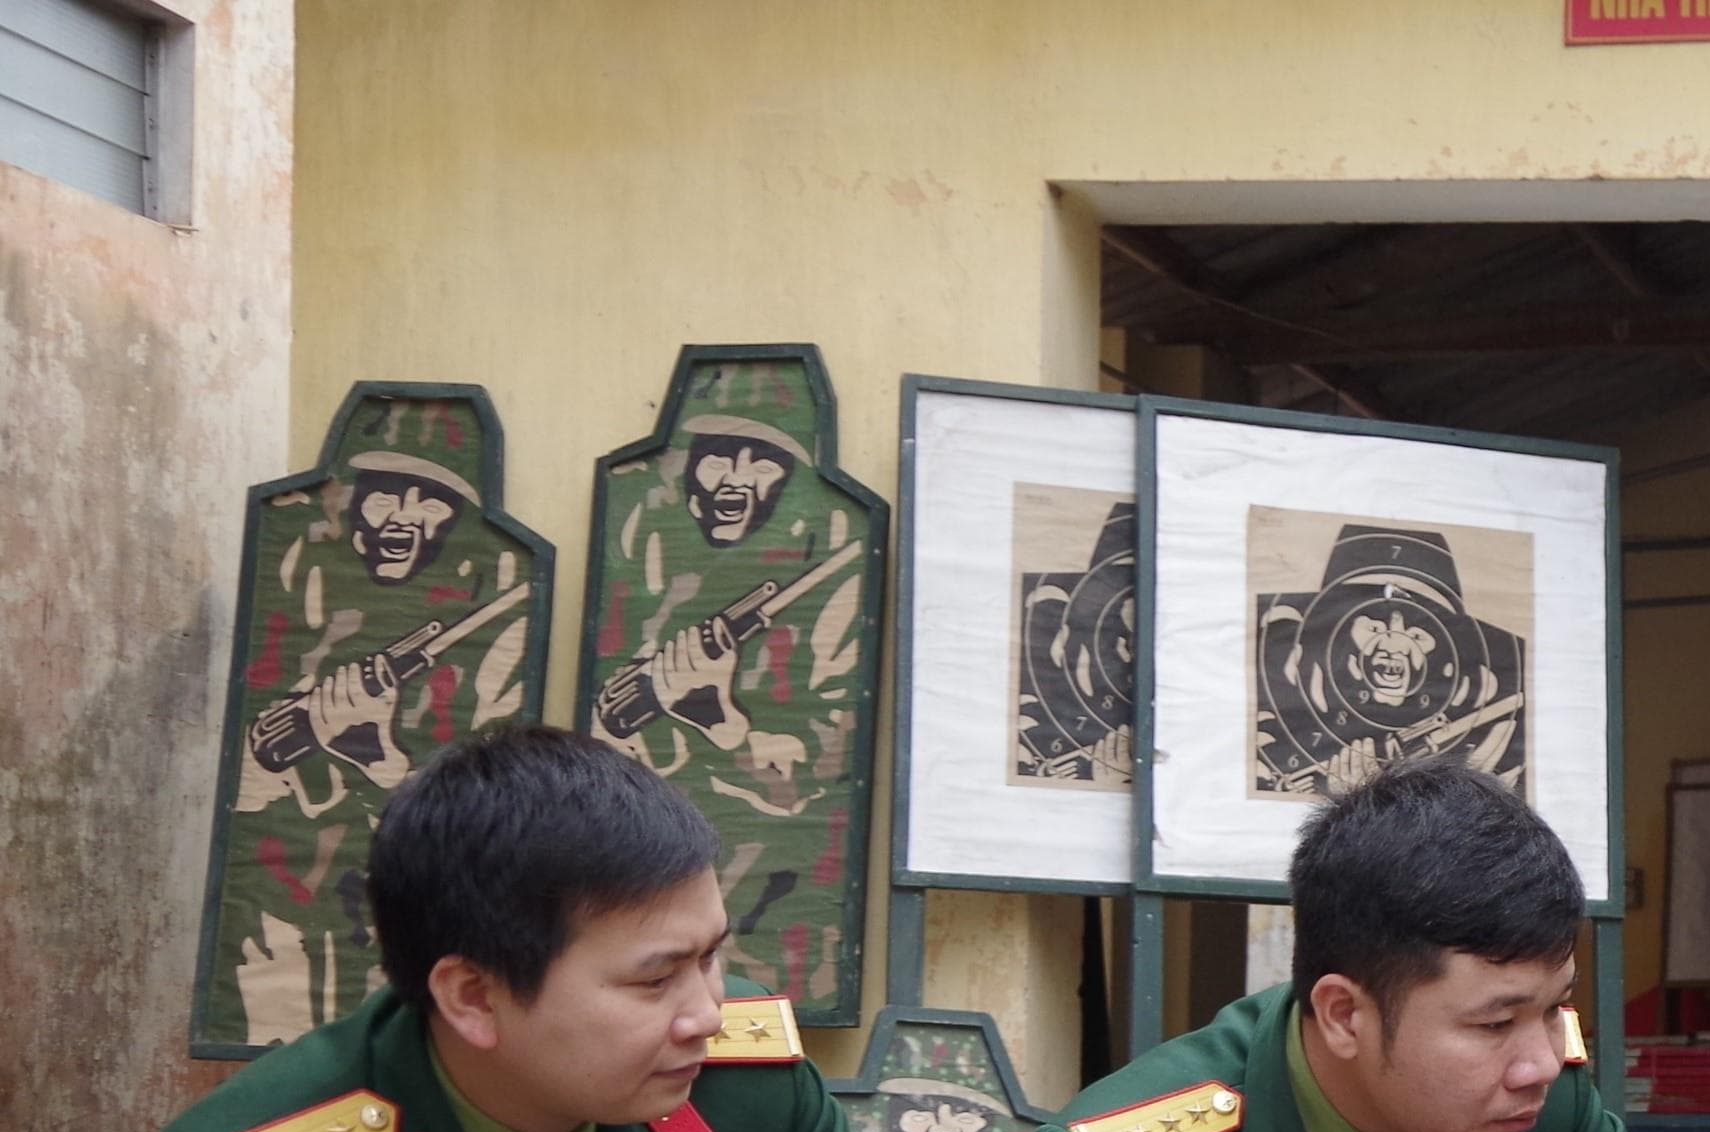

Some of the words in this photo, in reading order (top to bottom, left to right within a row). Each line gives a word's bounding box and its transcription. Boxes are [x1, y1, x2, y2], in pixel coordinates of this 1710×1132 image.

[1391, 545, 1402, 559] 7
[1102, 694, 1114, 709] 8
[1358, 690, 1370, 704] 9
[1420, 694, 1430, 708] 9
[1076, 716, 1087, 730] 7
[1336, 711, 1347, 726] 8
[1051, 740, 1063, 752] 6
[1312, 732, 1323, 747] 7
[1288, 754, 1299, 768] 6
